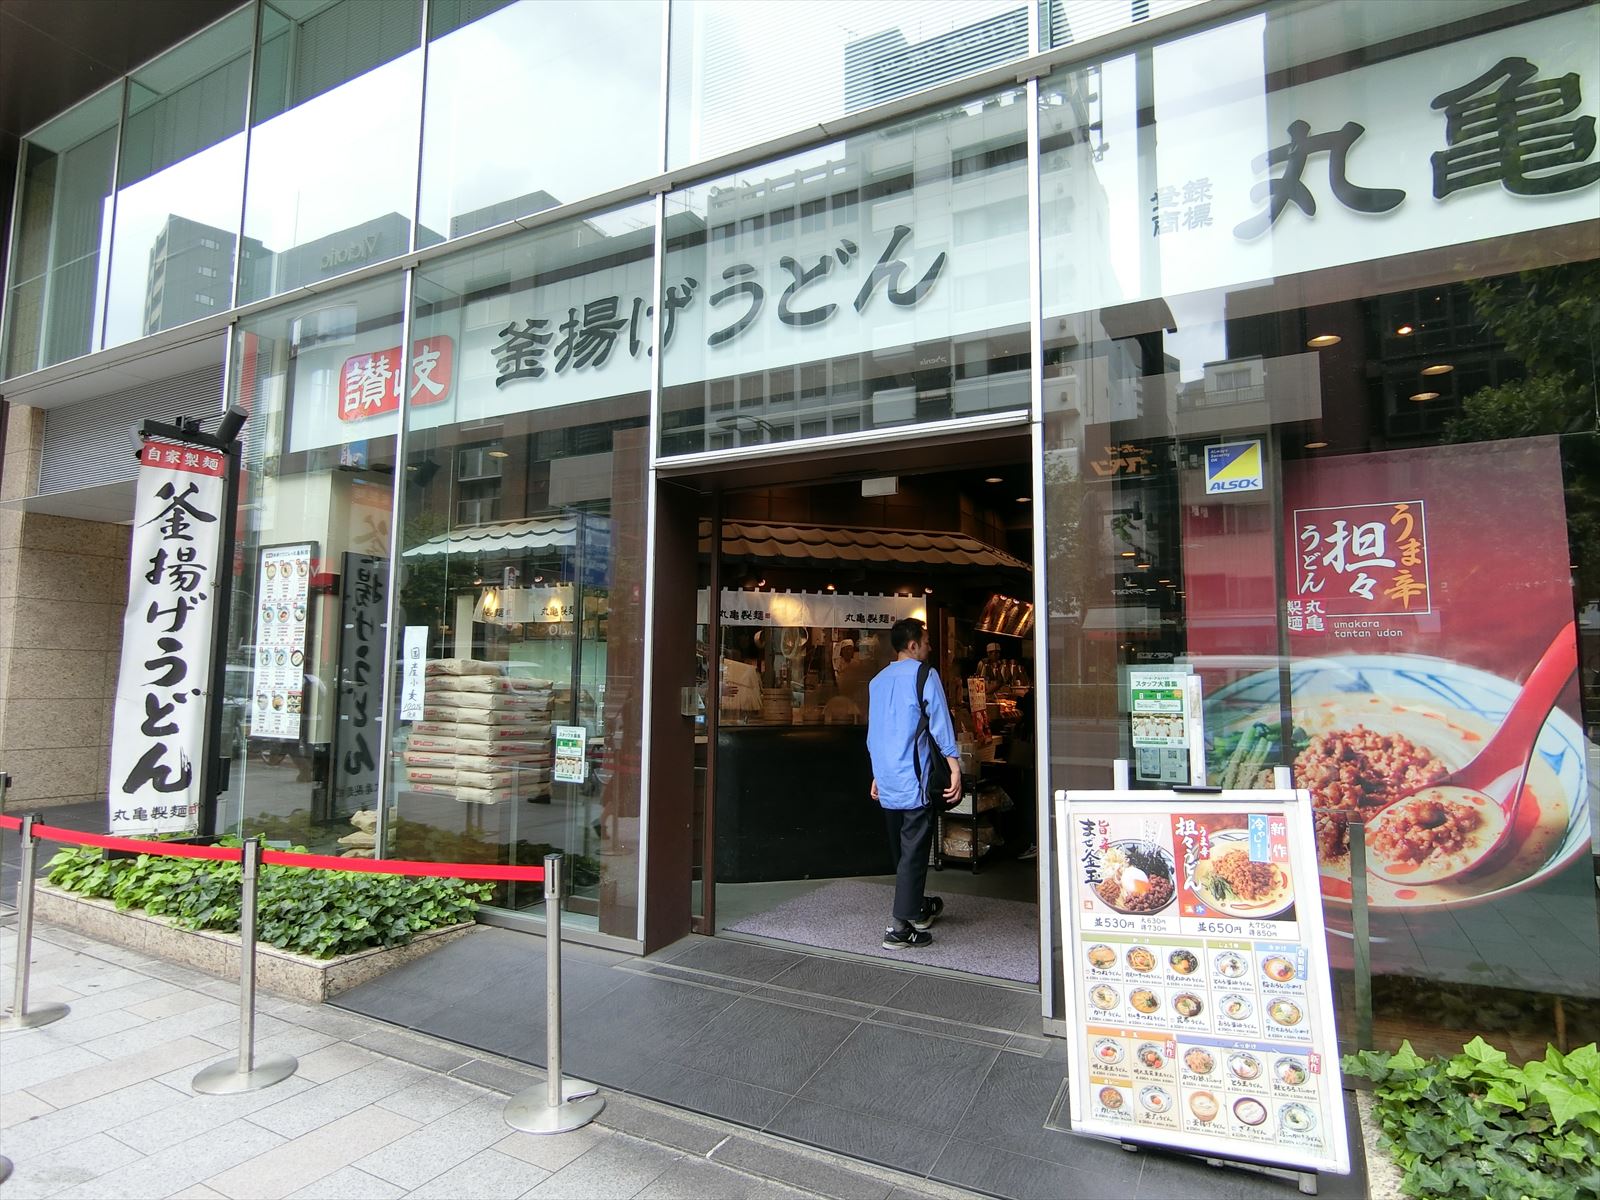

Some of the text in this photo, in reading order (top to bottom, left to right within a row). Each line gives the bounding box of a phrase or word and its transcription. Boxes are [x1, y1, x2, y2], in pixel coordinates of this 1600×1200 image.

[489, 224, 948, 390] 釜揚げうどん
[147, 446, 220, 471] 自家製麺
[1209, 478, 1259, 492] ALSOK
[1300, 524, 1326, 595] うどん
[1322, 519, 1396, 601] 担々
[1383, 503, 1427, 610] うま辛
[719, 609, 764, 621] 丸亀製麺
[844, 612, 889, 624] 丸亀製麺
[1304, 599, 1325, 632] 丸亀
[1333, 620, 1380, 629] umakara
[121, 480, 218, 795] 釜揚げうどん
[1334, 628, 1403, 638] tantan udon
[1135, 680, 1178, 688] スタッフ大募集
[112, 804, 188, 822] 丸亀製麺
[1270, 822, 1287, 858] 新作
[1078, 818, 1104, 884] まぜ釜玉
[1094, 917, 1135, 929] 並530円
[1198, 922, 1242, 934] 並650円
